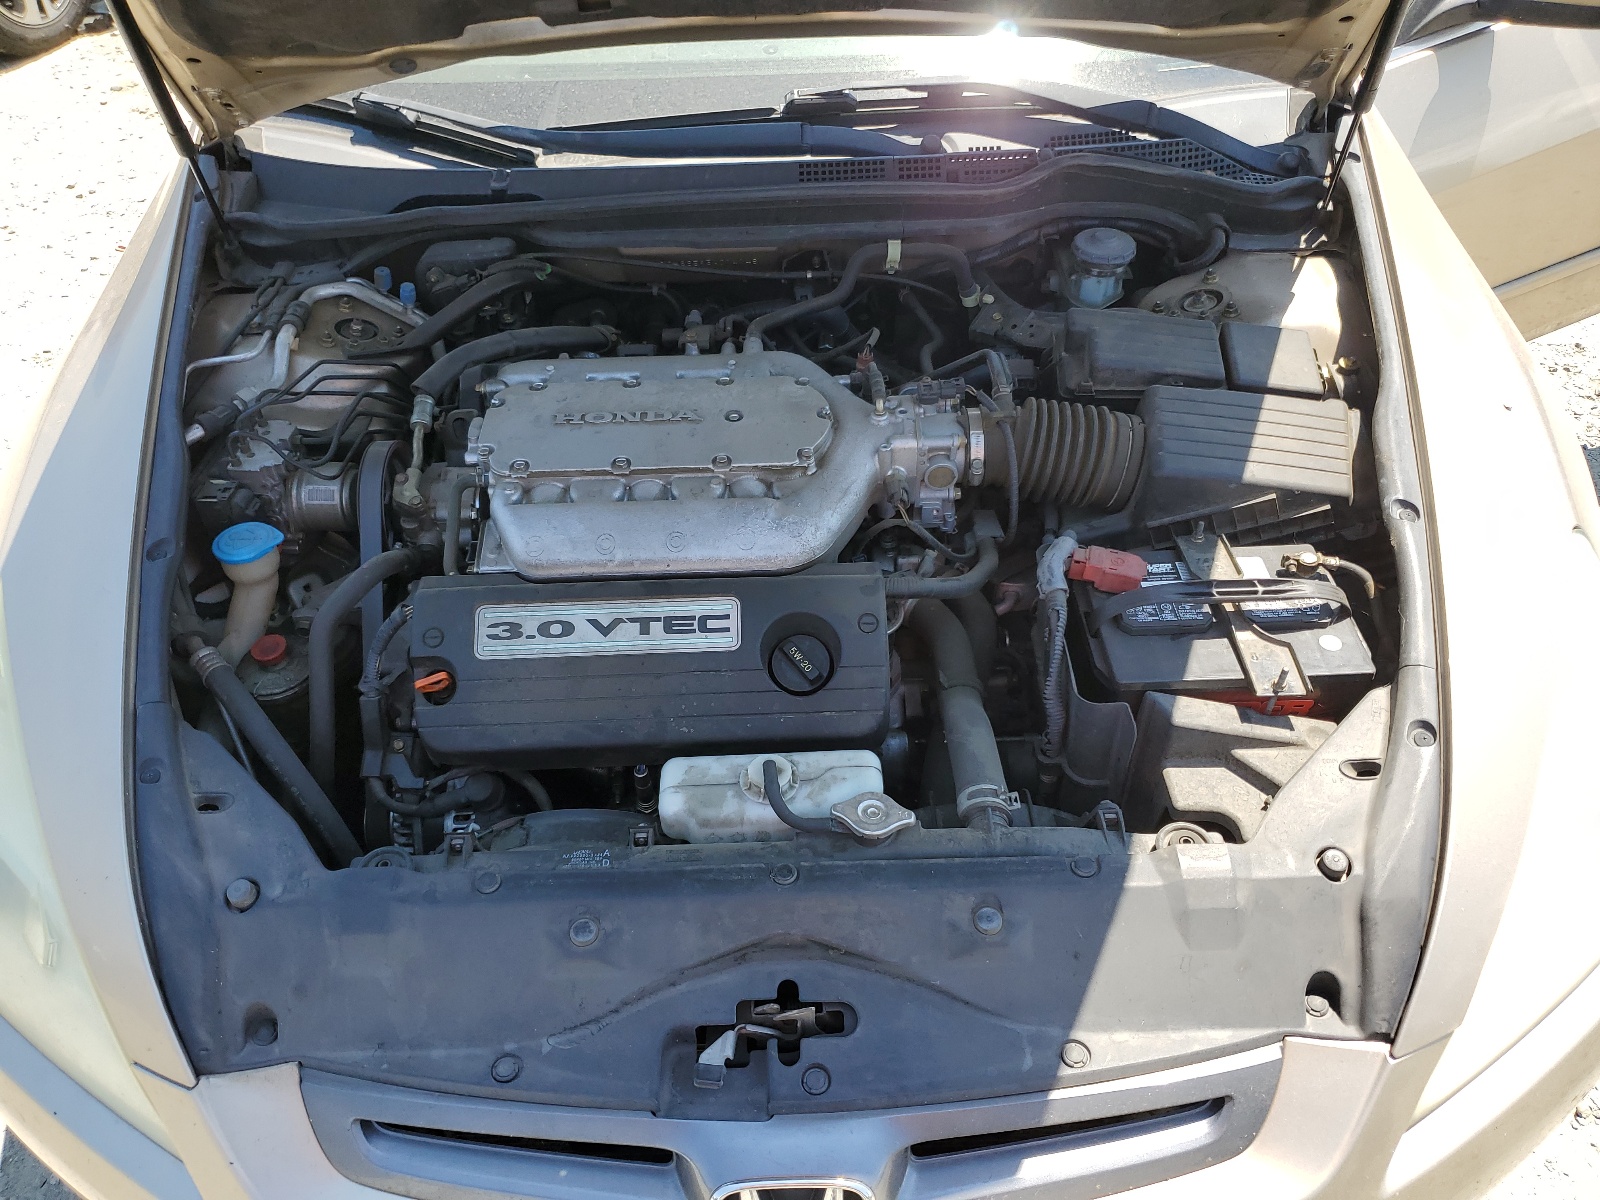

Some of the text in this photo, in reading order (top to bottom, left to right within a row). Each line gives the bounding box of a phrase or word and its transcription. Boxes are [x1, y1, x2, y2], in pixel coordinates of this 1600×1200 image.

[551, 410, 704, 424] HONDA
[486, 613, 731, 641] 3.0 VTEC
[789, 646, 813, 672] 5W-20
